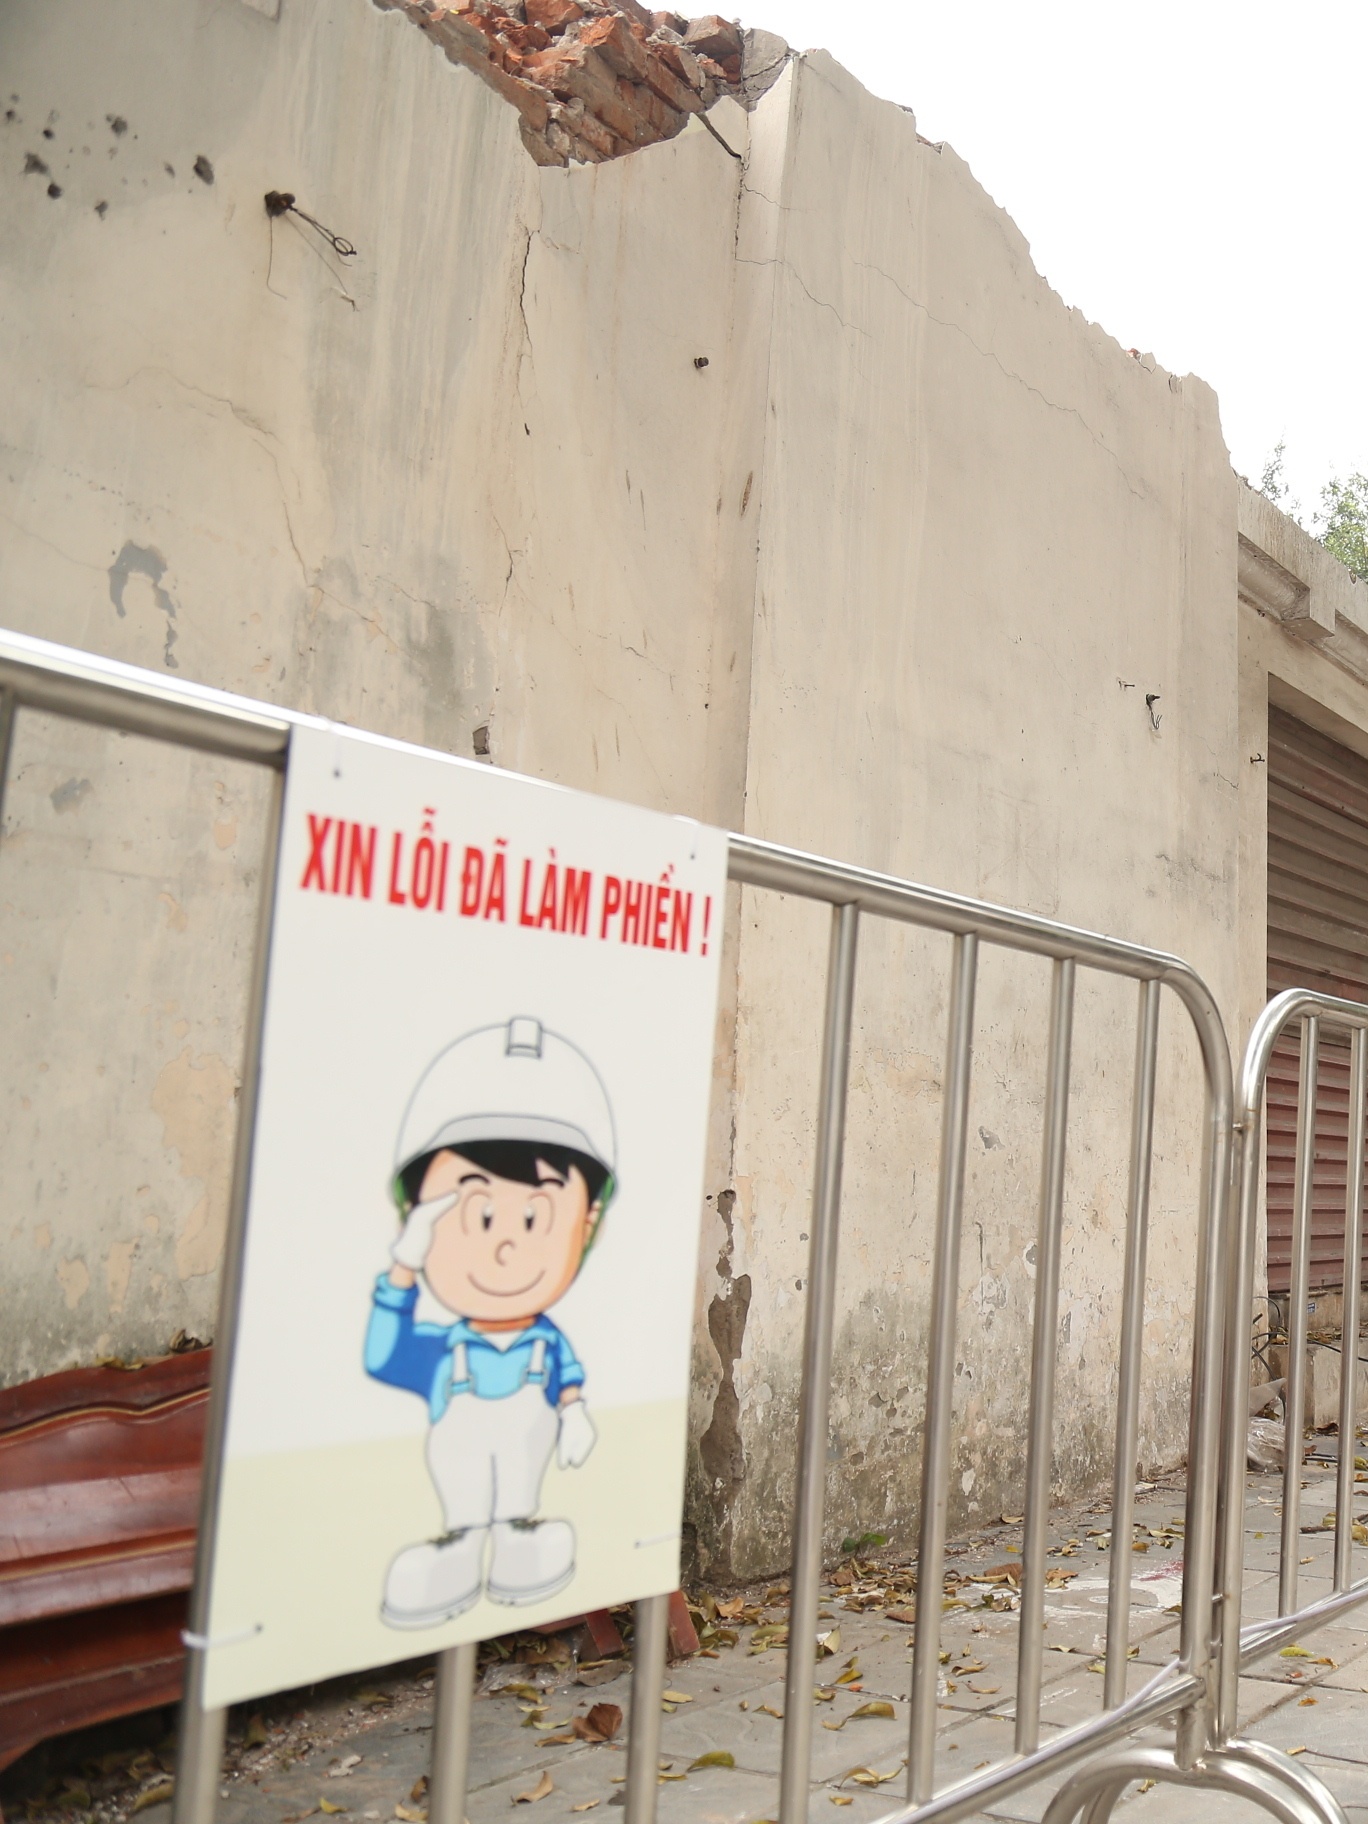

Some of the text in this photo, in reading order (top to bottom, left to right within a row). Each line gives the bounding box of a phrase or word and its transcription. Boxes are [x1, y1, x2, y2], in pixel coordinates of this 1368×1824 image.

[299, 812, 379, 901] XIN
[386, 807, 452, 914] LỖI
[458, 838, 509, 924] ĐÃ
[517, 848, 594, 938] LÀM
[599, 863, 694, 955] PHIỀN
